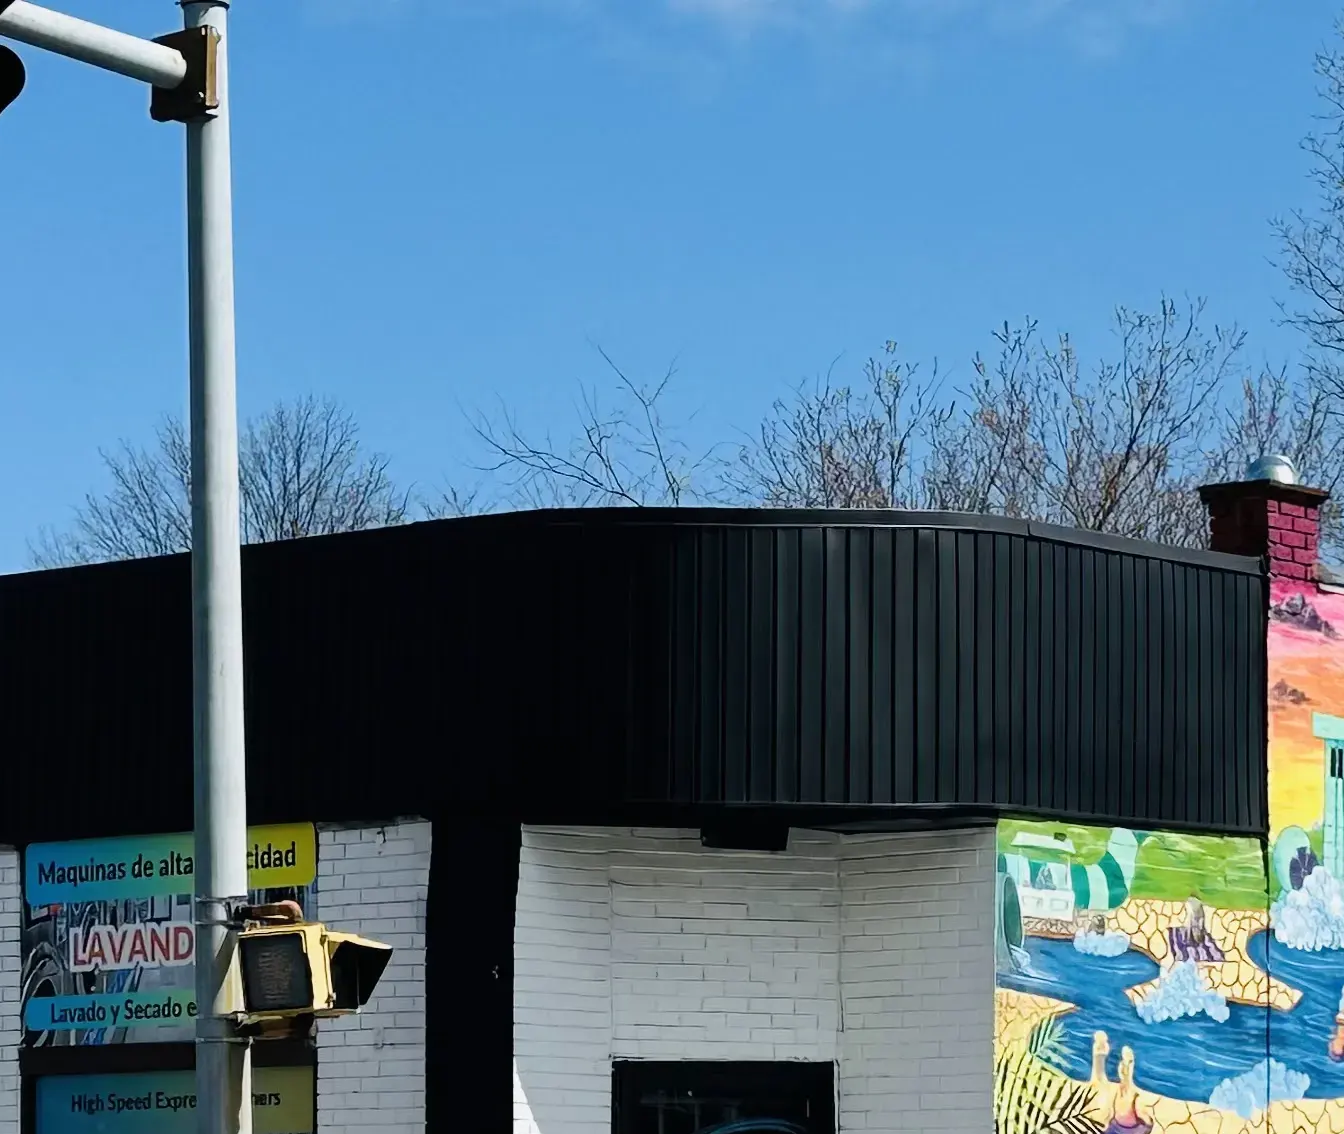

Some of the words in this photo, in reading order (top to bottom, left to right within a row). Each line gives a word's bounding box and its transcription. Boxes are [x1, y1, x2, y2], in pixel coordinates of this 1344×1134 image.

[38, 857, 126, 887] Maquinas
[132, 853, 153, 878] de
[159, 850, 194, 876] alta
[51, 1000, 106, 1023] Lavado
[111, 1005, 120, 1025] y
[124, 996, 182, 1020] Secado
[71, 1094, 104, 1115] High
[107, 1092, 151, 1114] Speed
[155, 1091, 197, 1112] Expre
